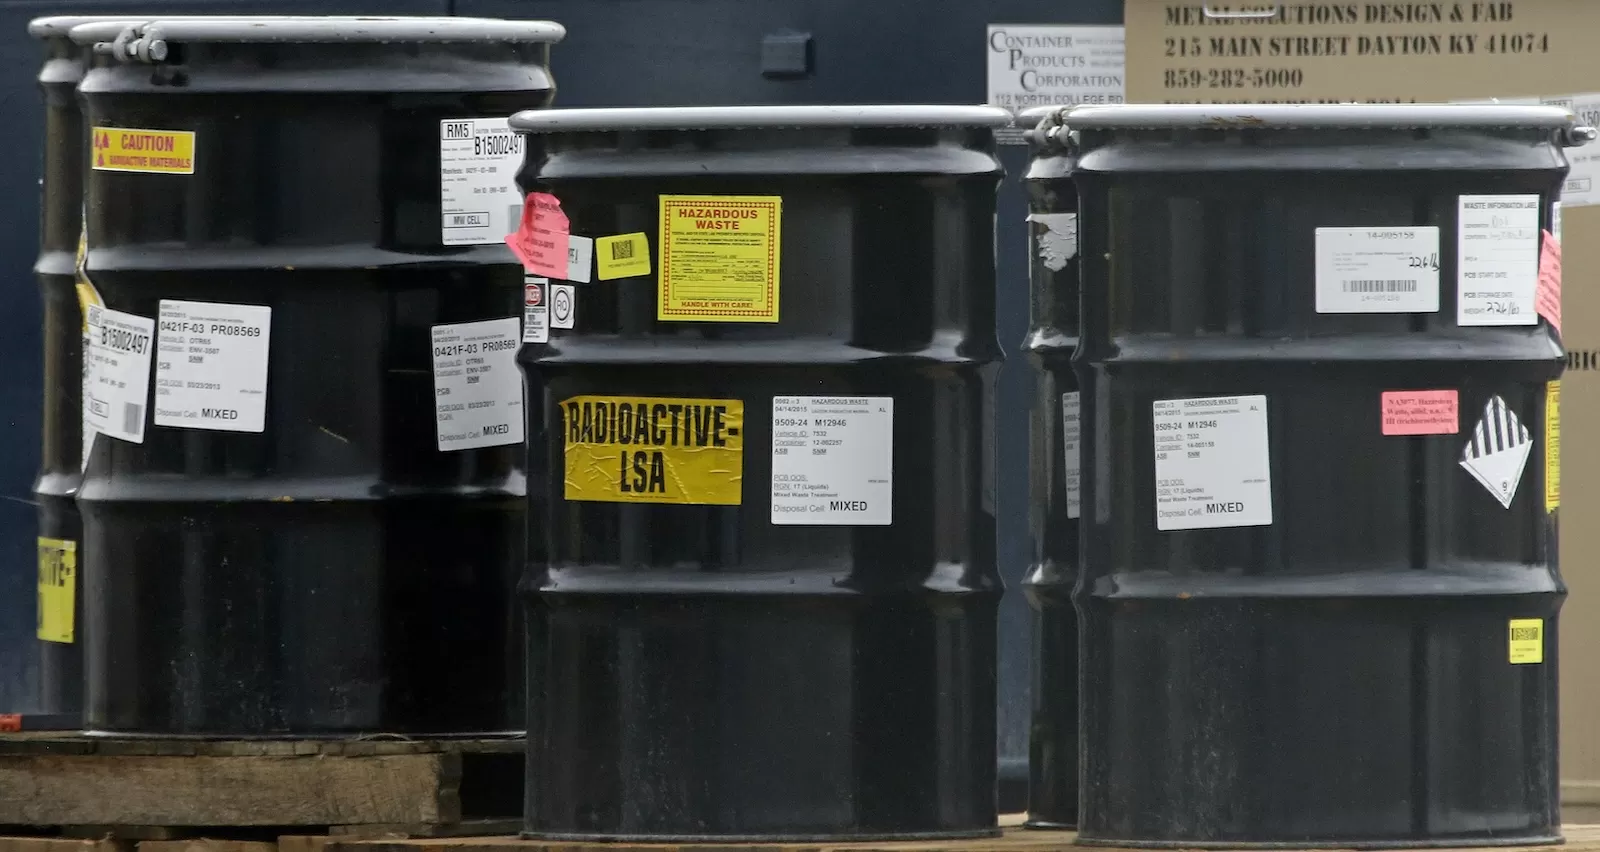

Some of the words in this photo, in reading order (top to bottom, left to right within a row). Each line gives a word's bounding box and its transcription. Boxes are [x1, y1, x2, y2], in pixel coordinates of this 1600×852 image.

[1364, 4, 1442, 23] DESIGN
[1450, 4, 1464, 22] &
[1472, 3, 1513, 22] FAB
[990, 30, 1073, 53] CONTAINER
[1165, 37, 1202, 57] 215
[1210, 37, 1262, 57] MAIN
[1269, 36, 1350, 57] STREET
[1358, 35, 1442, 55] DAYTON
[1450, 34, 1477, 54] KY
[1484, 33, 1549, 54] 41074
[1009, 49, 1086, 70] PRODUCTS
[1020, 70, 1122, 92] CORPORATION
[1164, 68, 1303, 88] 859-282-5000
[1015, 94, 1052, 104] NORTH
[1054, 94, 1104, 104] COLLEGE
[447, 124, 470, 138] RM5
[122, 134, 174, 152] CAUTION
[475, 136, 522, 155] B15002497
[467, 216, 480, 224] CELL
[679, 209, 758, 219] HAZARDOUS
[696, 220, 740, 230] WASTE
[557, 300, 568, 312] RQ
[160, 321, 204, 334] 0421F-03
[211, 324, 260, 337] PR08569
[102, 326, 149, 355] B15002497
[434, 344, 478, 356] 0421F-03
[482, 340, 516, 352] PR08569
[202, 408, 238, 420] MIXED
[483, 424, 509, 436] MIXED
[568, 402, 738, 446] RADIOACTIVE-
[1156, 423, 1182, 431] 9509-24
[1188, 420, 1217, 428] M12946
[620, 451, 666, 493] LSA
[830, 501, 868, 511] MIXED
[1206, 502, 1244, 514] MIXED
